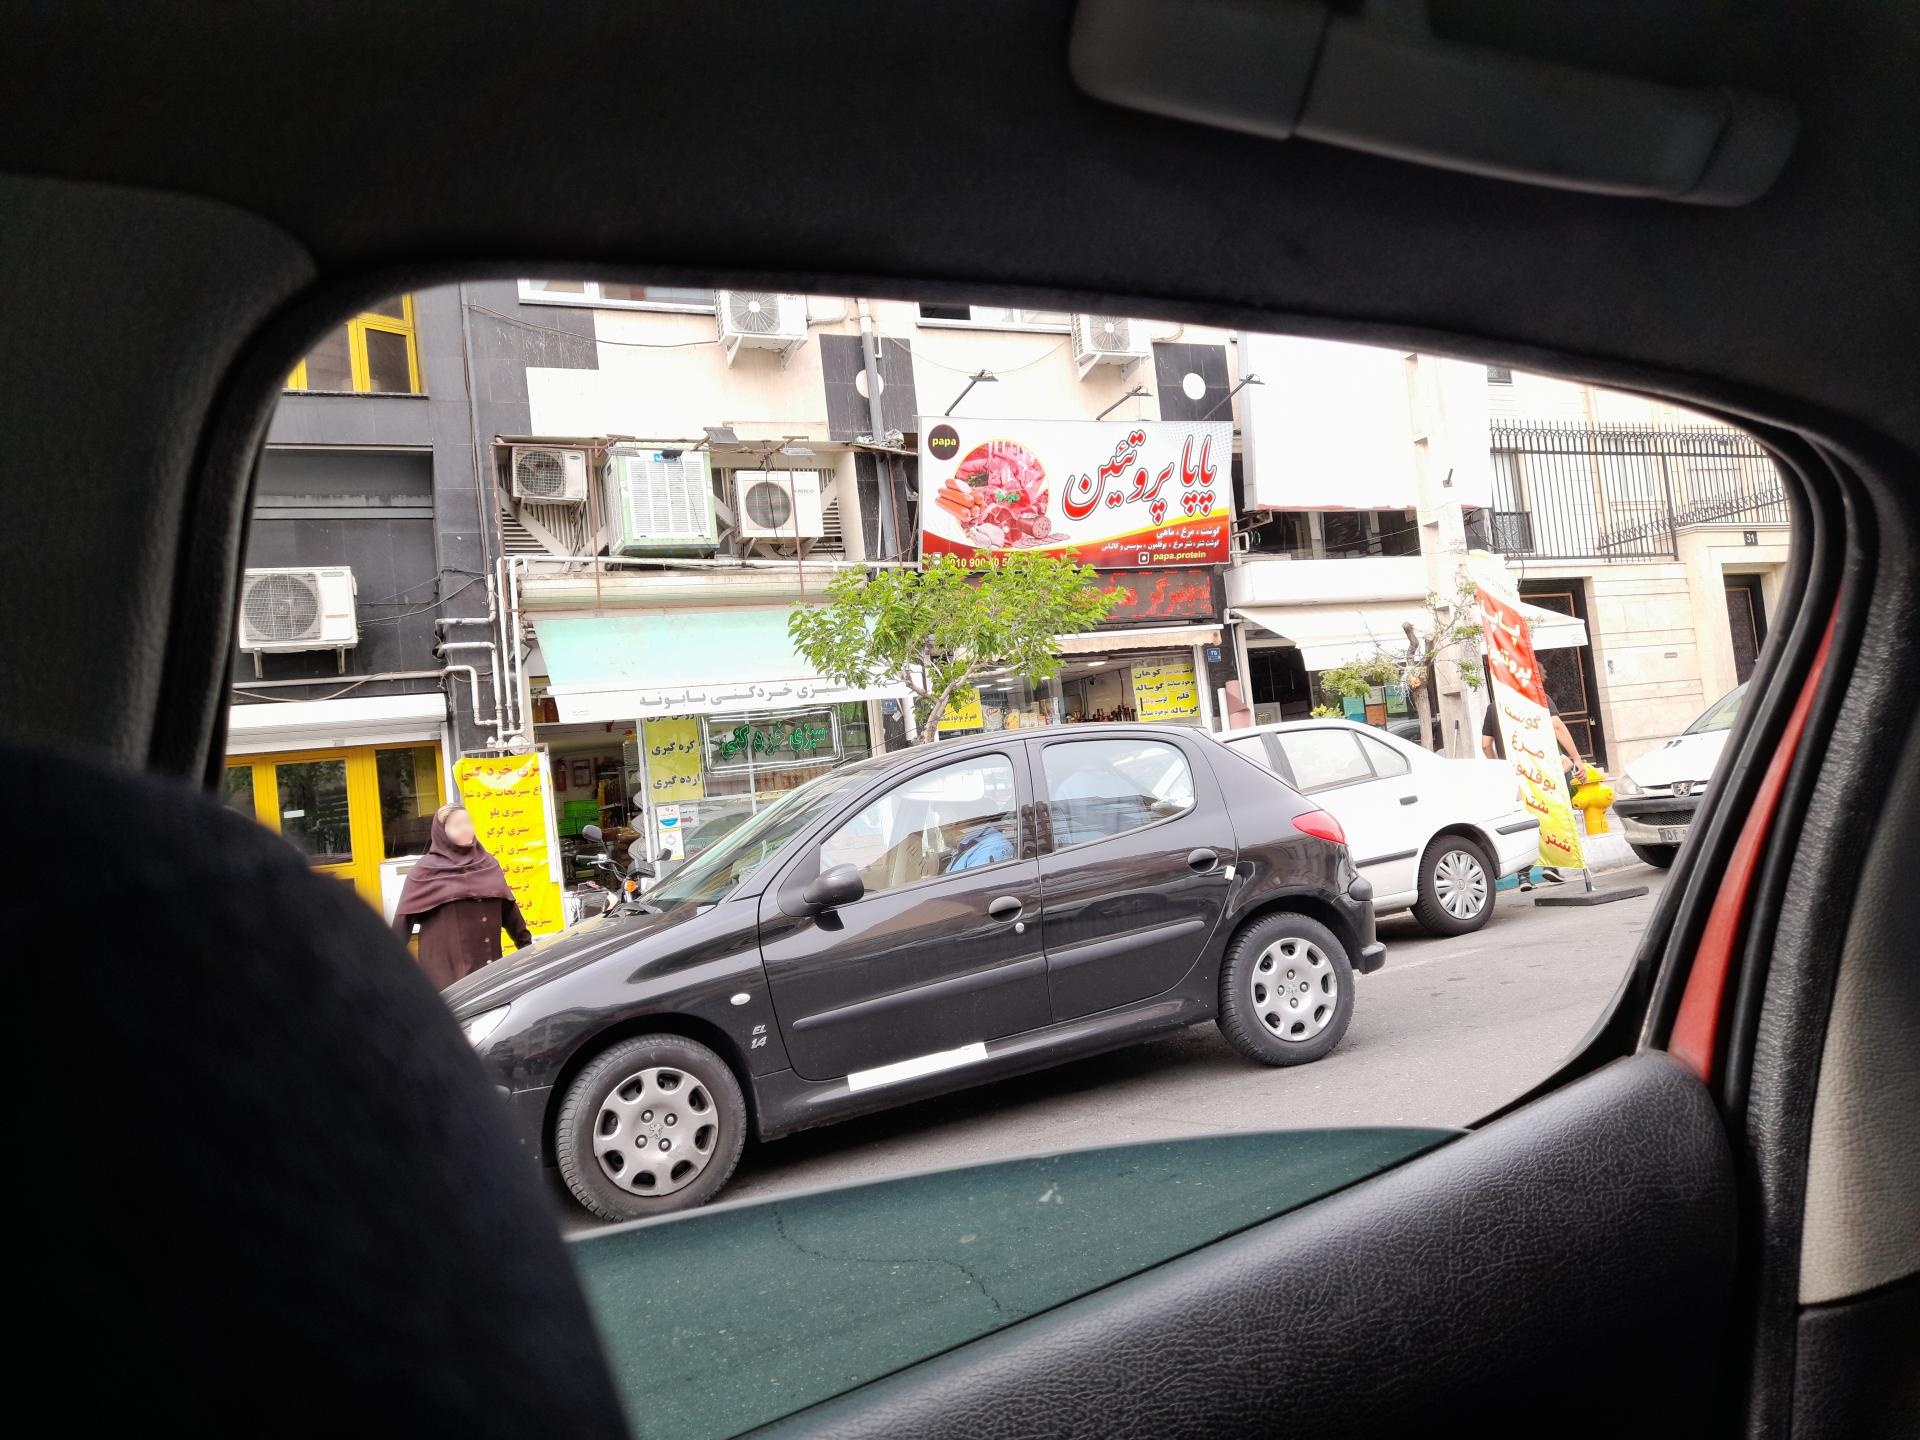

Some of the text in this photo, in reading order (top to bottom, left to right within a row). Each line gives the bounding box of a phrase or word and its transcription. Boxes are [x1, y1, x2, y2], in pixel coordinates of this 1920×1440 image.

[932, 437, 957, 448] papa
[1062, 429, 1217, 526] پاپا پروتئین
[1156, 527, 1175, 538] ماهی
[1153, 551, 1206, 562] papa.protein
[639, 689, 706, 709] بابونه
[678, 740, 695, 753] کره
[752, 1024, 767, 1036] EL
